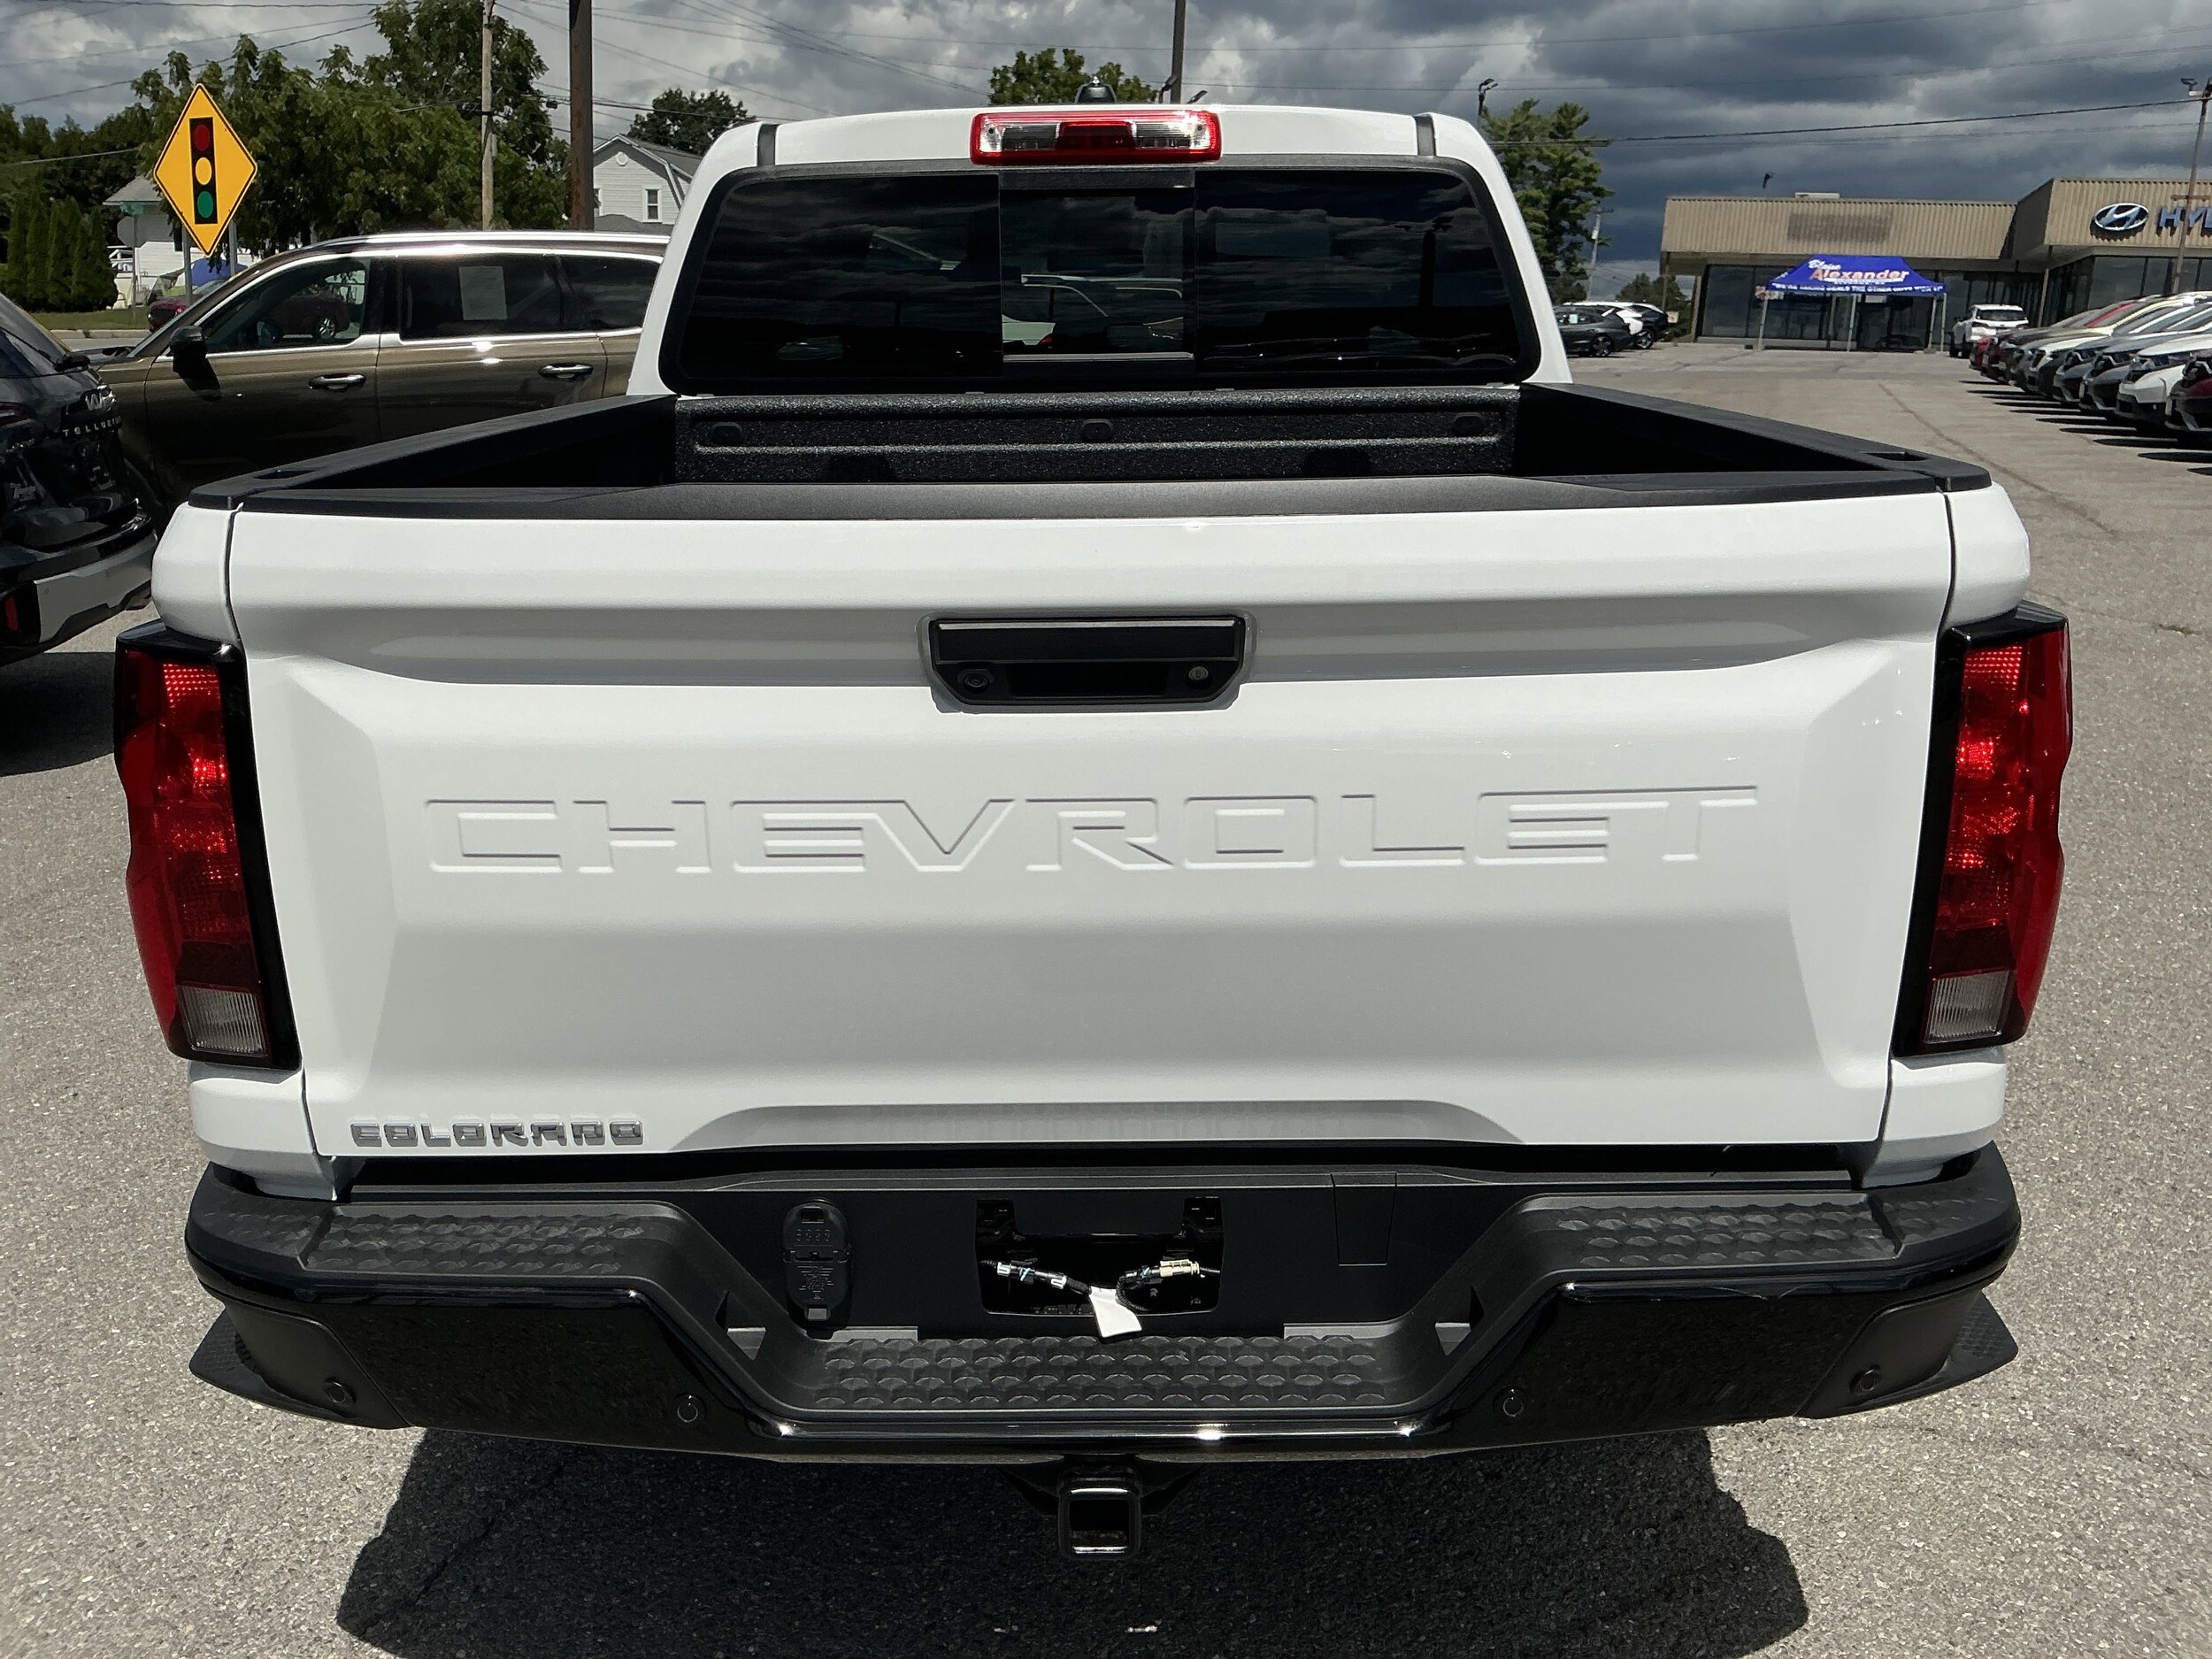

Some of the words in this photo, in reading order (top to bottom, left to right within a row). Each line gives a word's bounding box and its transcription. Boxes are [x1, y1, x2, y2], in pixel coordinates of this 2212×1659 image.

[2159, 204, 2212, 228] HY
[1809, 269, 1910, 281] Alexander
[425, 785, 1758, 874] CHEVROLET
[349, 1120, 644, 1148] COLORADO
